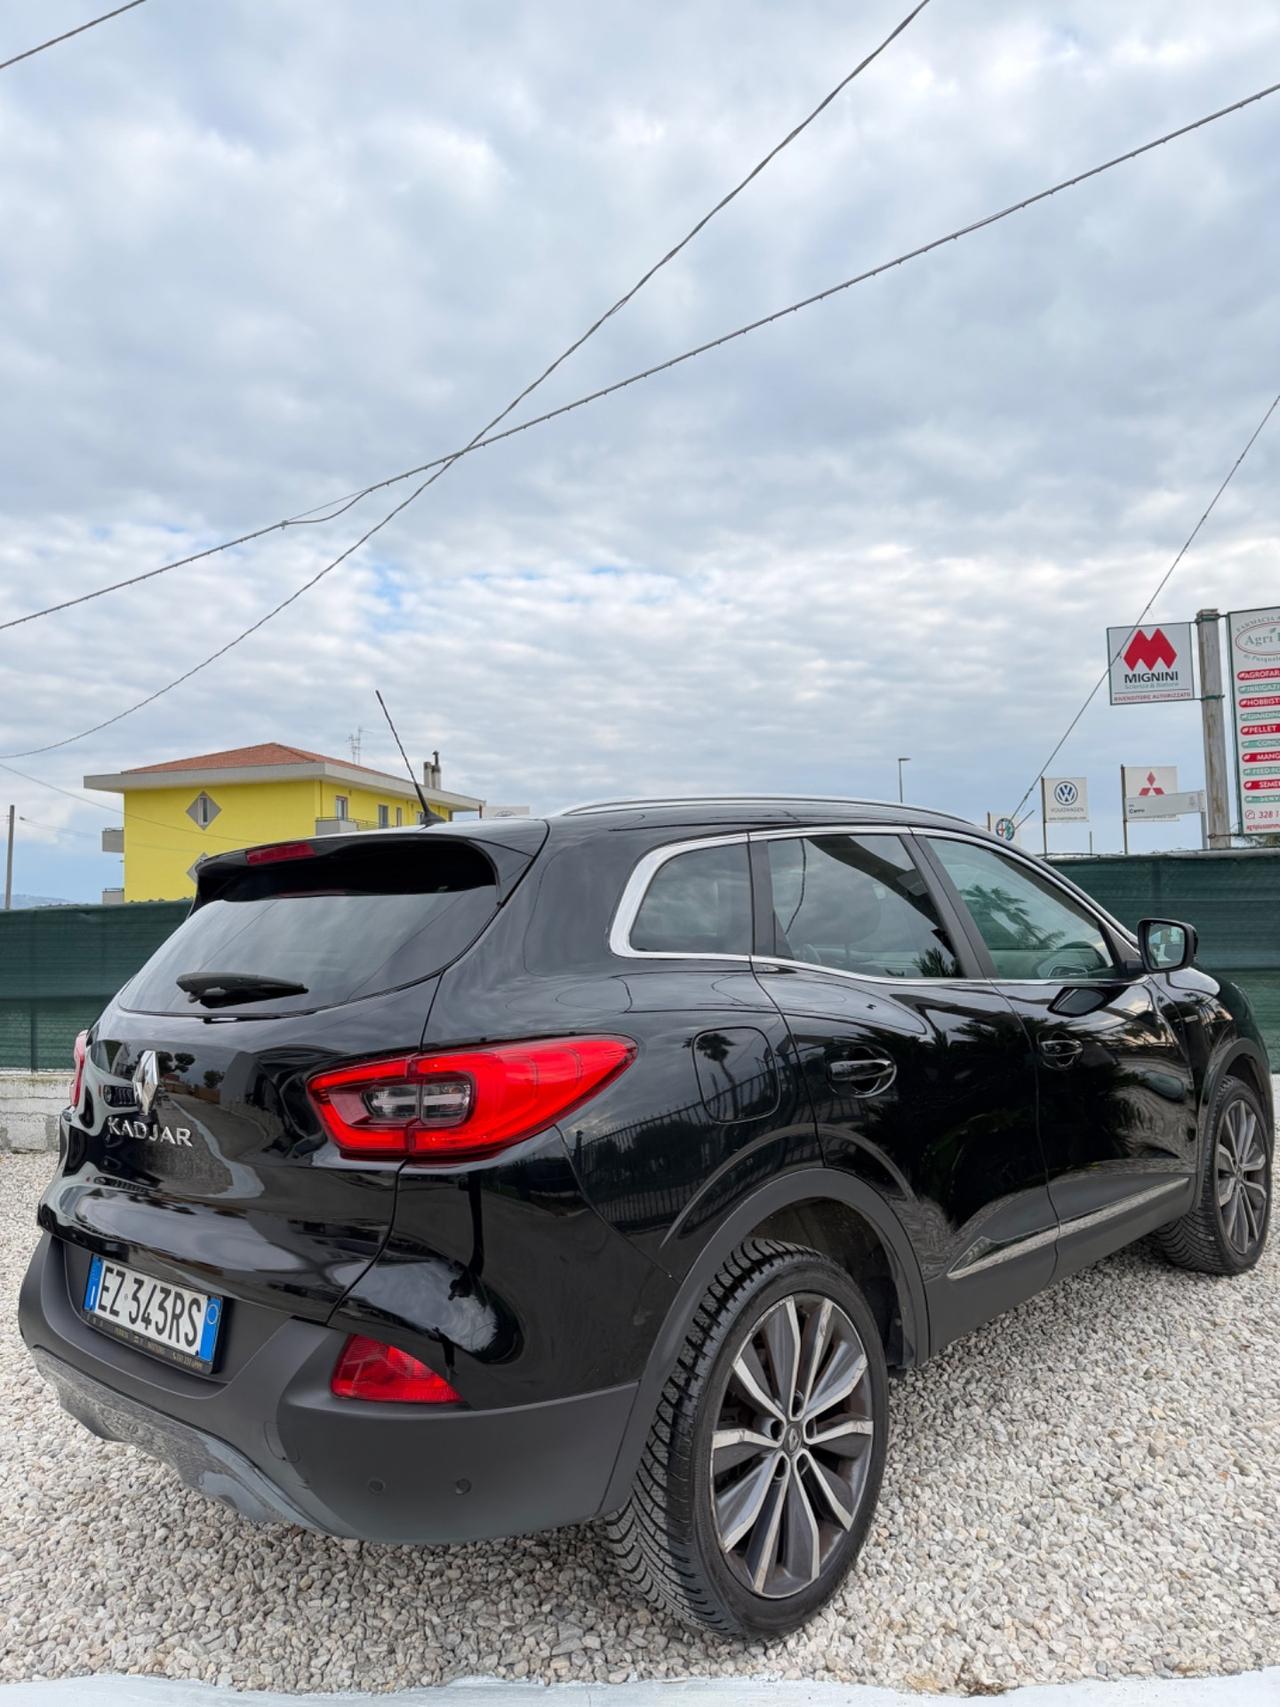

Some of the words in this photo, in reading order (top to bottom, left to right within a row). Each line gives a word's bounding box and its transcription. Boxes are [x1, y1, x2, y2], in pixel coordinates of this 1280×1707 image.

[1124, 671, 1179, 684] MIGNINI
[1249, 724, 1277, 733] PELLET
[1258, 810, 1273, 819] 328
[107, 1117, 193, 1148] KADJAR
[97, 1264, 126, 1318] EZ
[128, 1277, 202, 1348] 343RS
